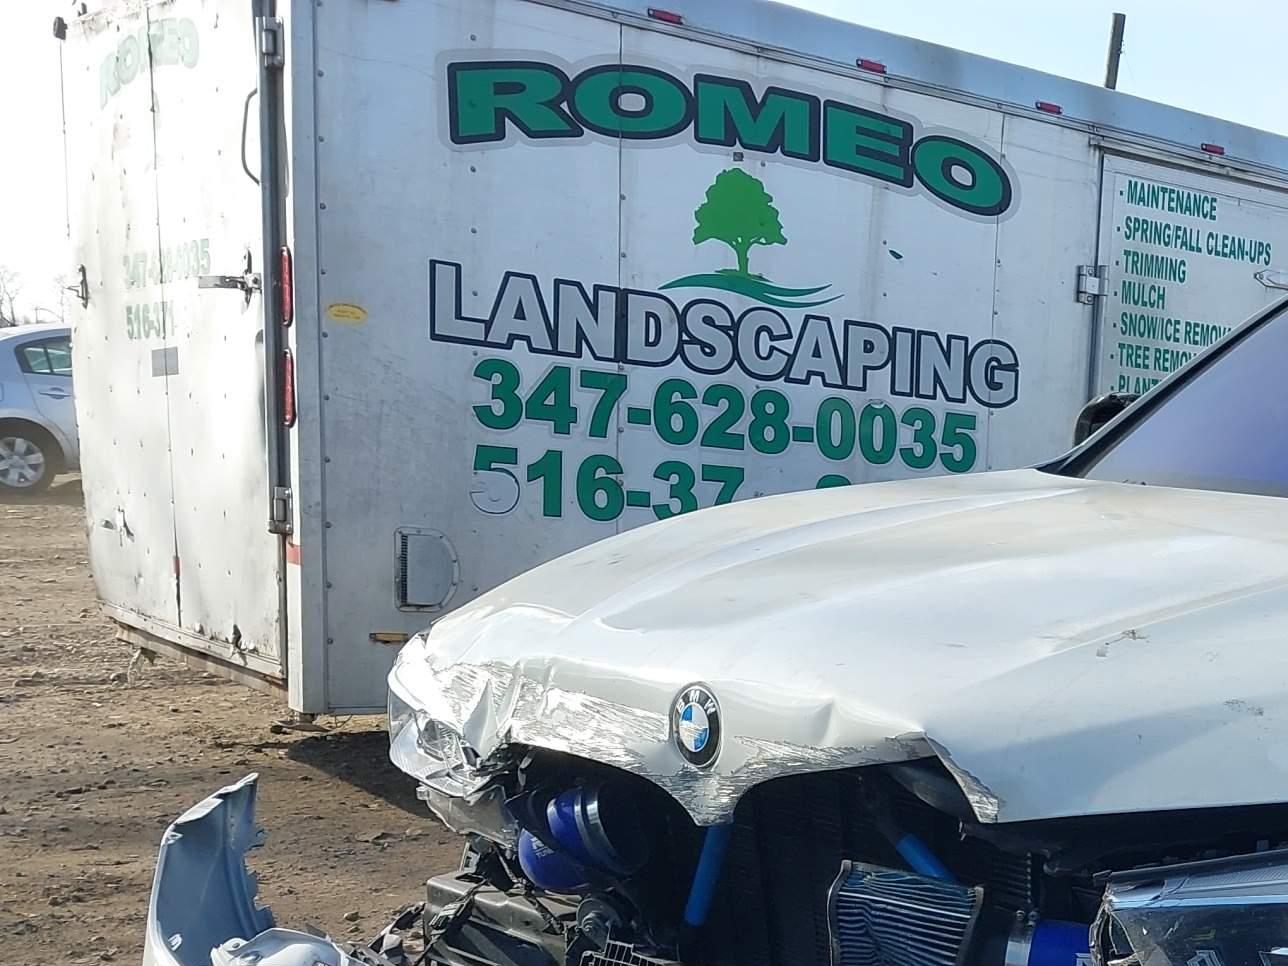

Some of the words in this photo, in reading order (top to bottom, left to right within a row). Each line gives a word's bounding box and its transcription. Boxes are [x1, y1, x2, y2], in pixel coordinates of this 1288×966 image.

[447, 60, 1013, 216] ROMEO
[1127, 180, 1218, 221] MAINTENANCE
[1124, 215, 1202, 253] SPRING/FALL
[1206, 231, 1272, 266] CLEAN-UPS
[1123, 249, 1187, 283] TRIMMING
[1121, 280, 1166, 310] MULCH
[429, 259, 1020, 408] LANDSCAPING
[1120, 311, 1181, 343] SNOW/ICE
[1184, 320, 1232, 347] REMOV
[1117, 342, 1150, 370] TREE
[1118, 374, 1163, 395] PLAN
[471, 357, 977, 474] 347-628-0035
[675, 689, 717, 715] BMW
